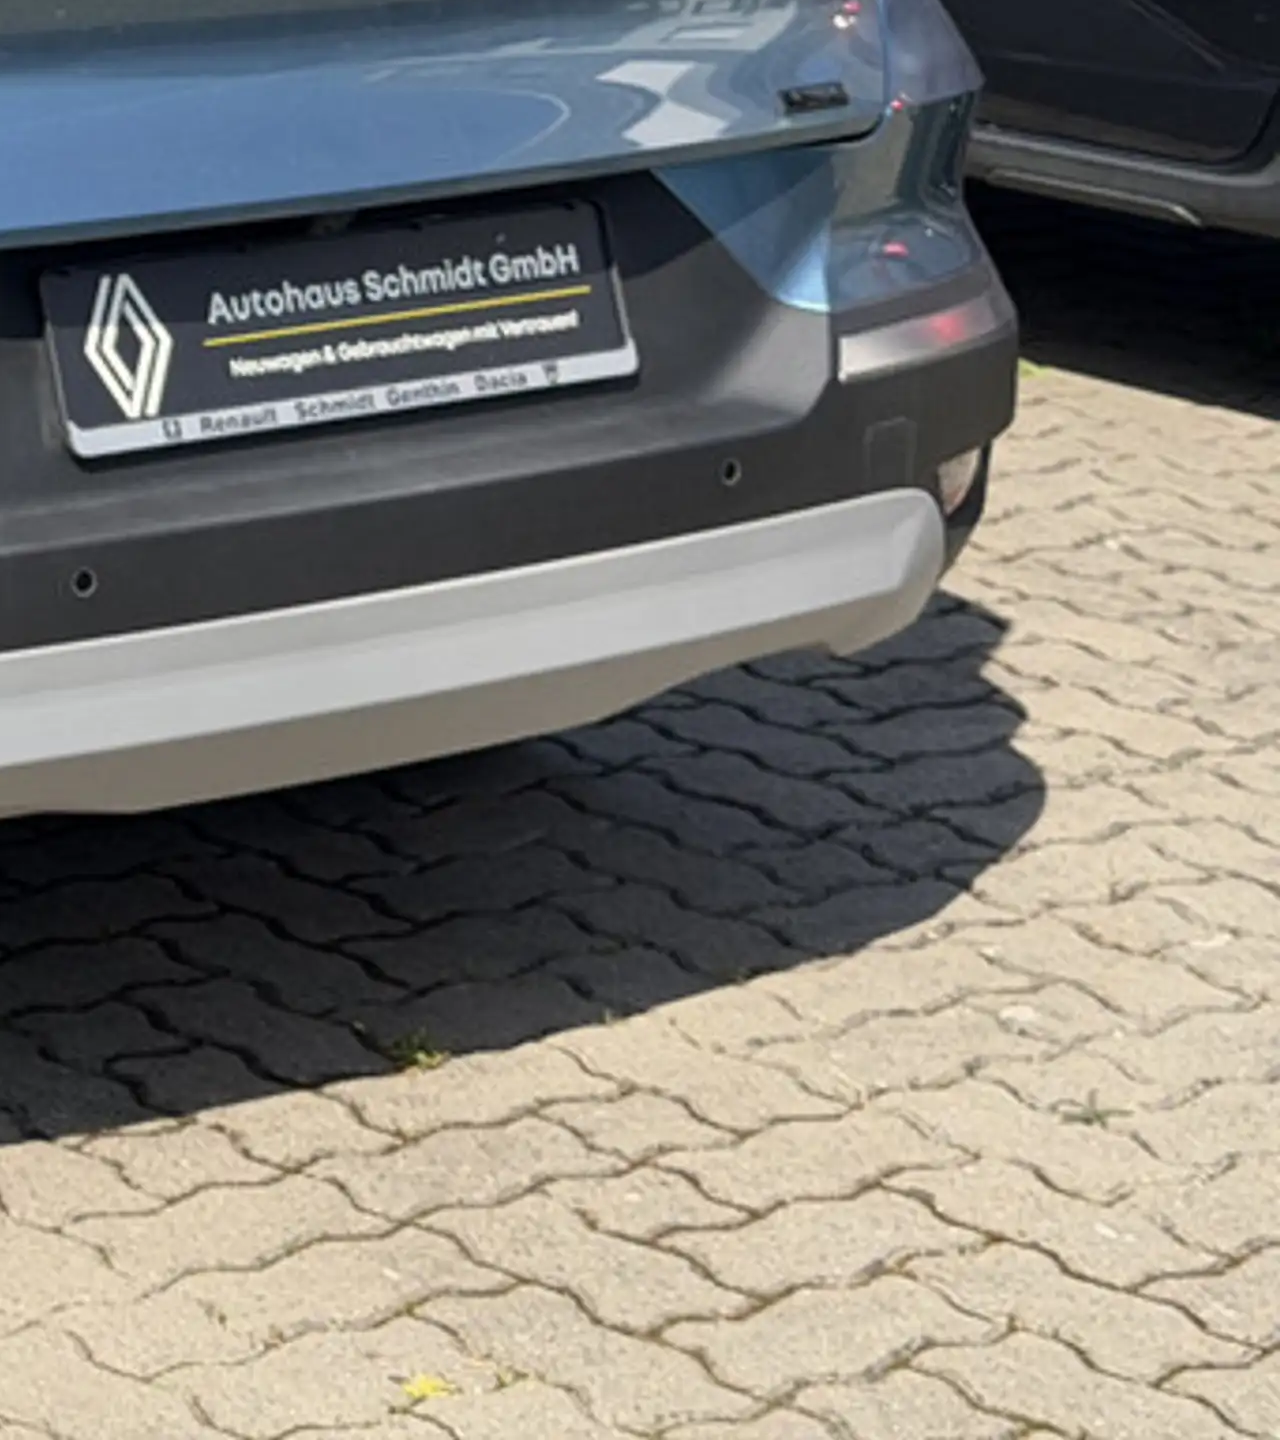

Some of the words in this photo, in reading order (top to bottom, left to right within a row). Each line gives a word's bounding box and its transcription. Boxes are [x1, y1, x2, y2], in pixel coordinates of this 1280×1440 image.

[206, 279, 362, 326] Autohaus
[362, 255, 487, 302] Schmidt
[488, 243, 581, 283] GmbH
[200, 407, 278, 433] Renault
[294, 392, 376, 420] Schmidt
[475, 371, 529, 392] Dacia
